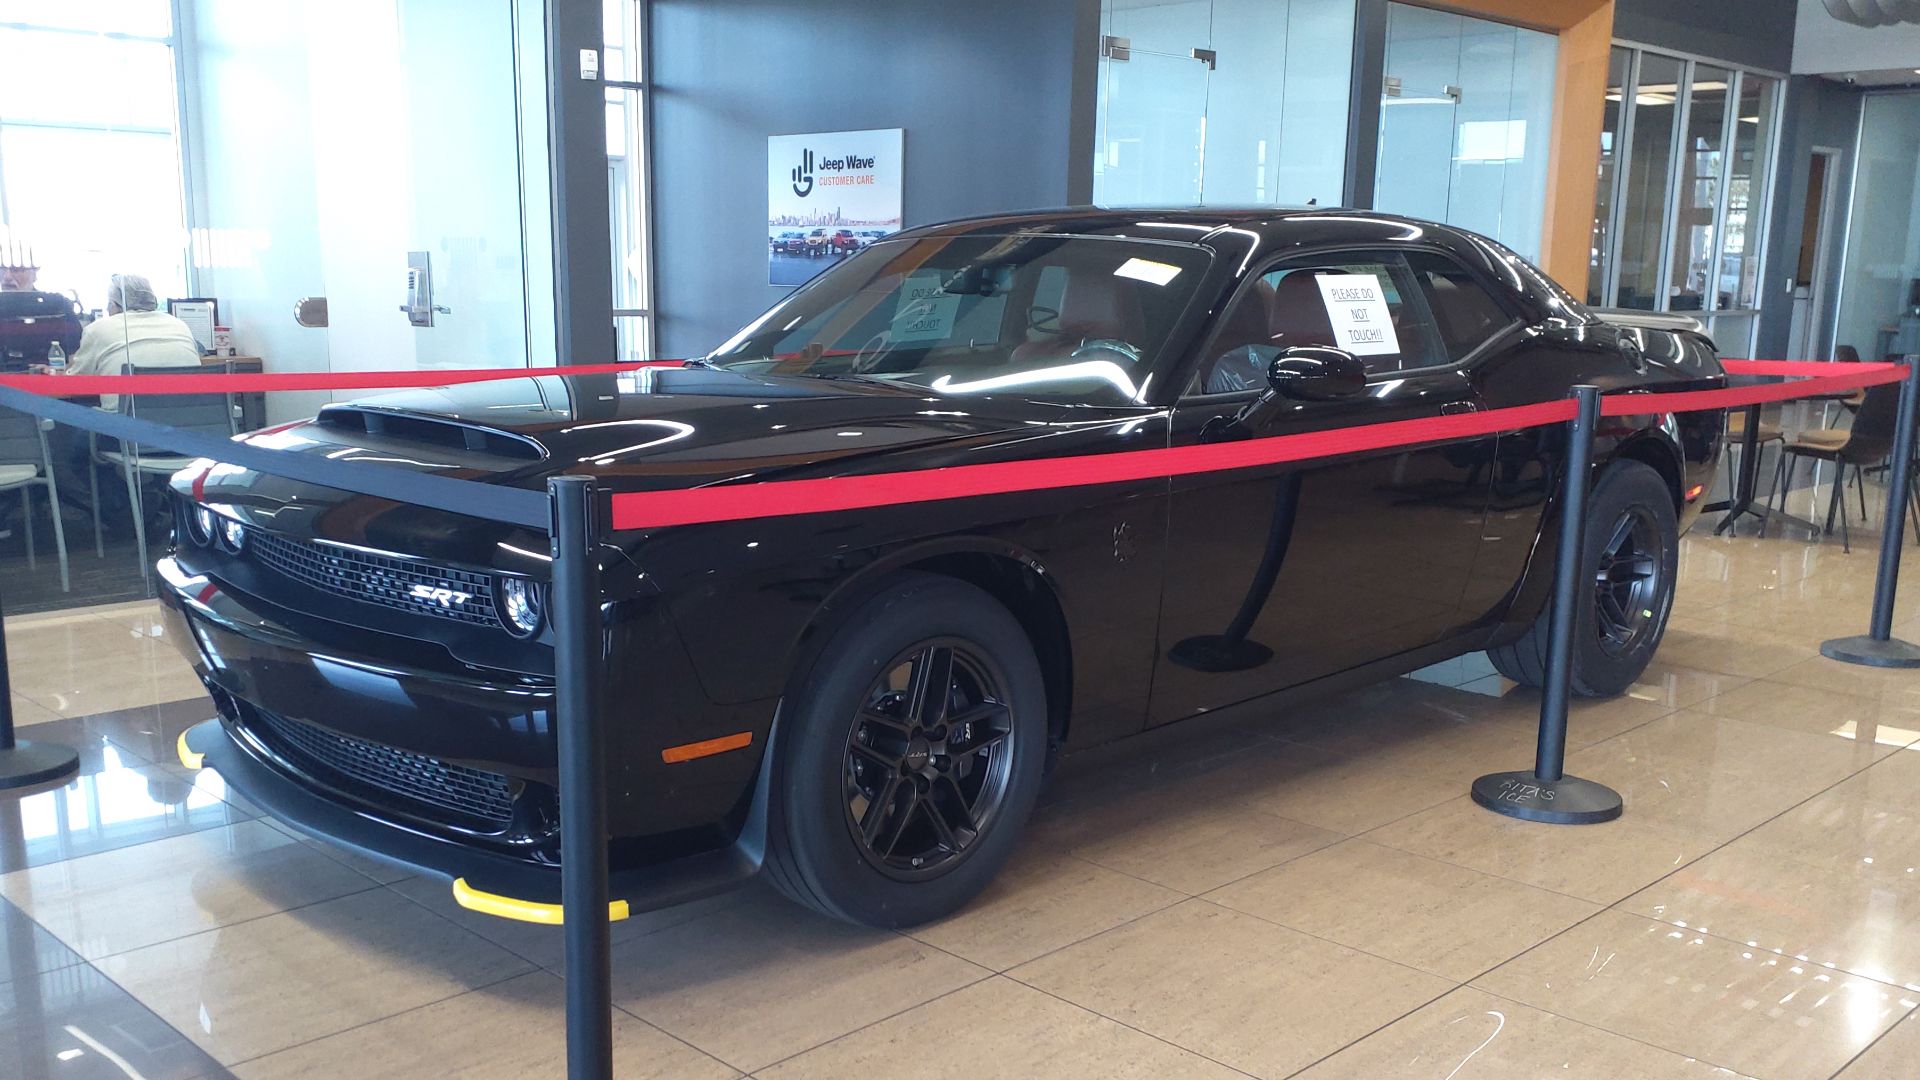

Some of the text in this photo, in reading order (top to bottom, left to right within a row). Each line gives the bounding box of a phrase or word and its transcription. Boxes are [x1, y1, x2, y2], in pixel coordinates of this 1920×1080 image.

[819, 155, 874, 172] Jeep Wave
[819, 175, 874, 186] CUSTOMER CARE
[1331, 288, 1374, 299] PLEASE DO
[1351, 308, 1369, 320] NOT
[1348, 328, 1383, 341] TOUCH!!
[409, 585, 474, 607] SRT
[1498, 791, 1531, 804] ICE
